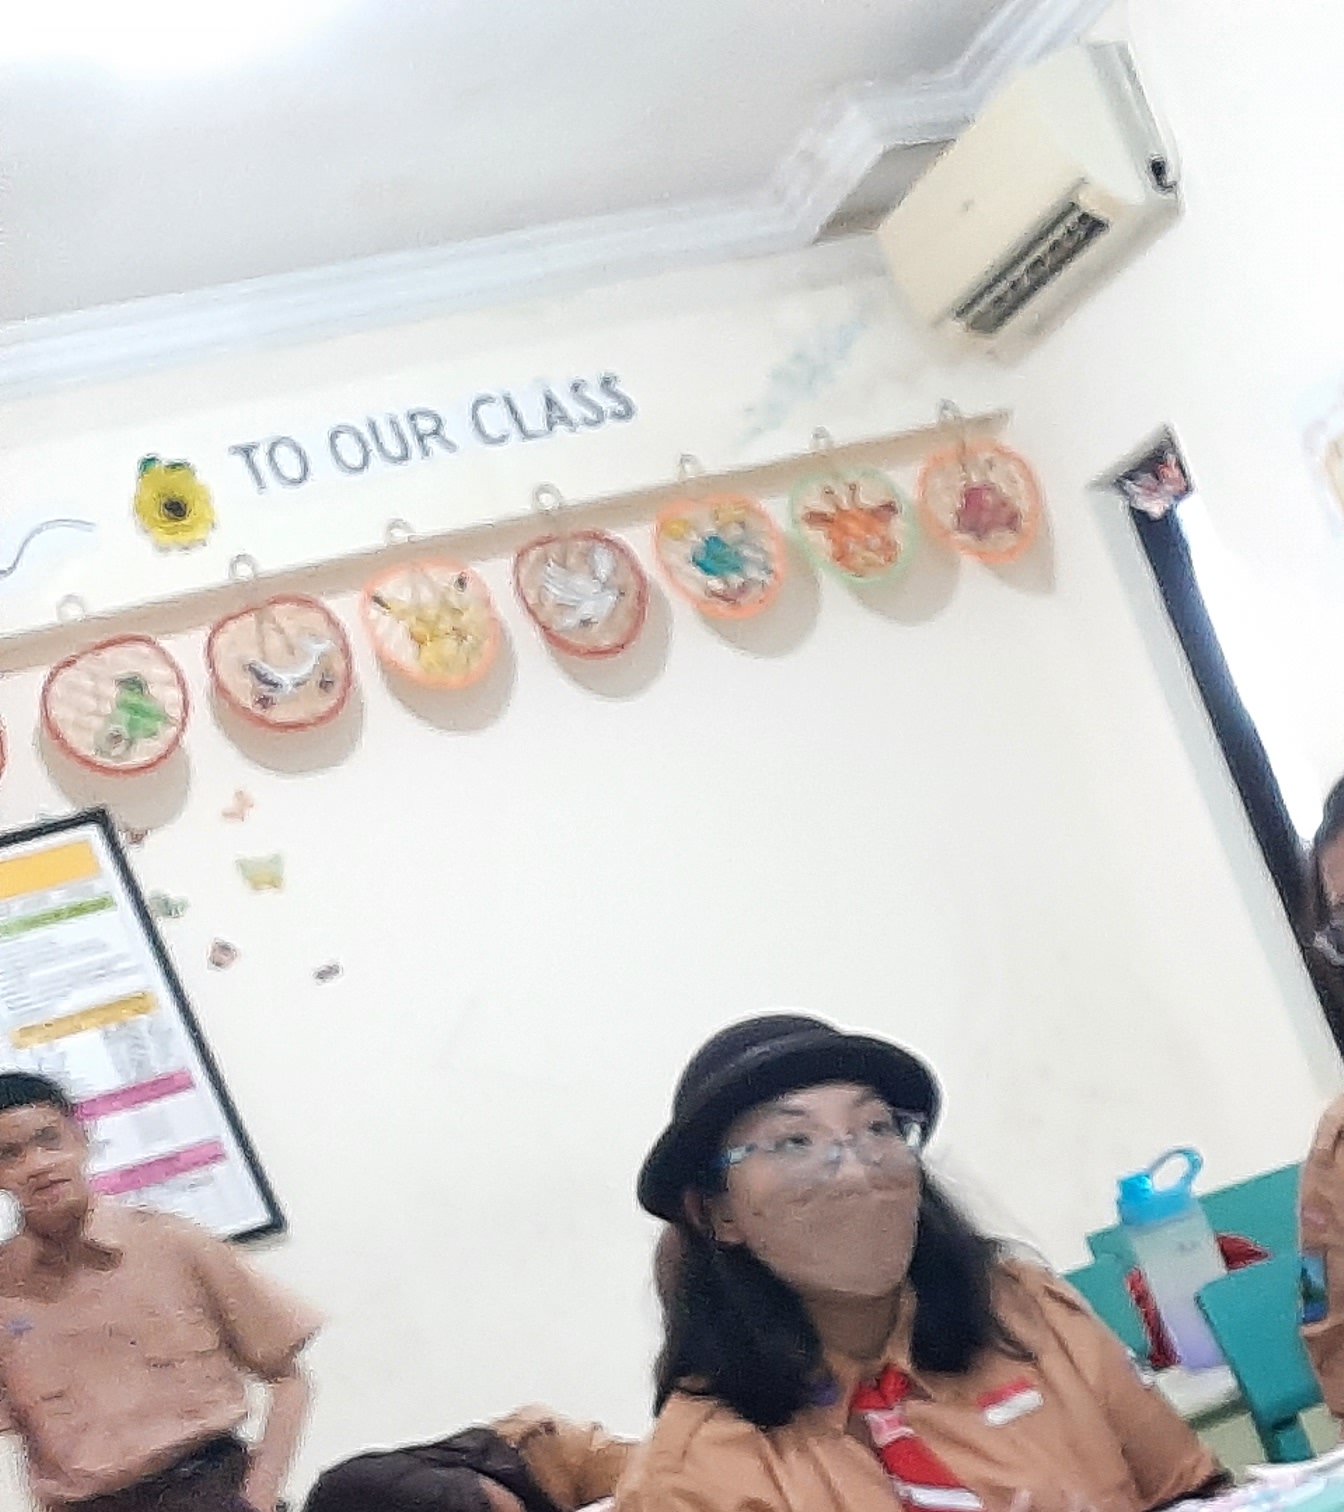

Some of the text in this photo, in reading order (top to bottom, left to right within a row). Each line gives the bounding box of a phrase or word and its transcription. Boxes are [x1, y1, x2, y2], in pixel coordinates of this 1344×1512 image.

[228, 371, 639, 494] TO OUR CLASS
